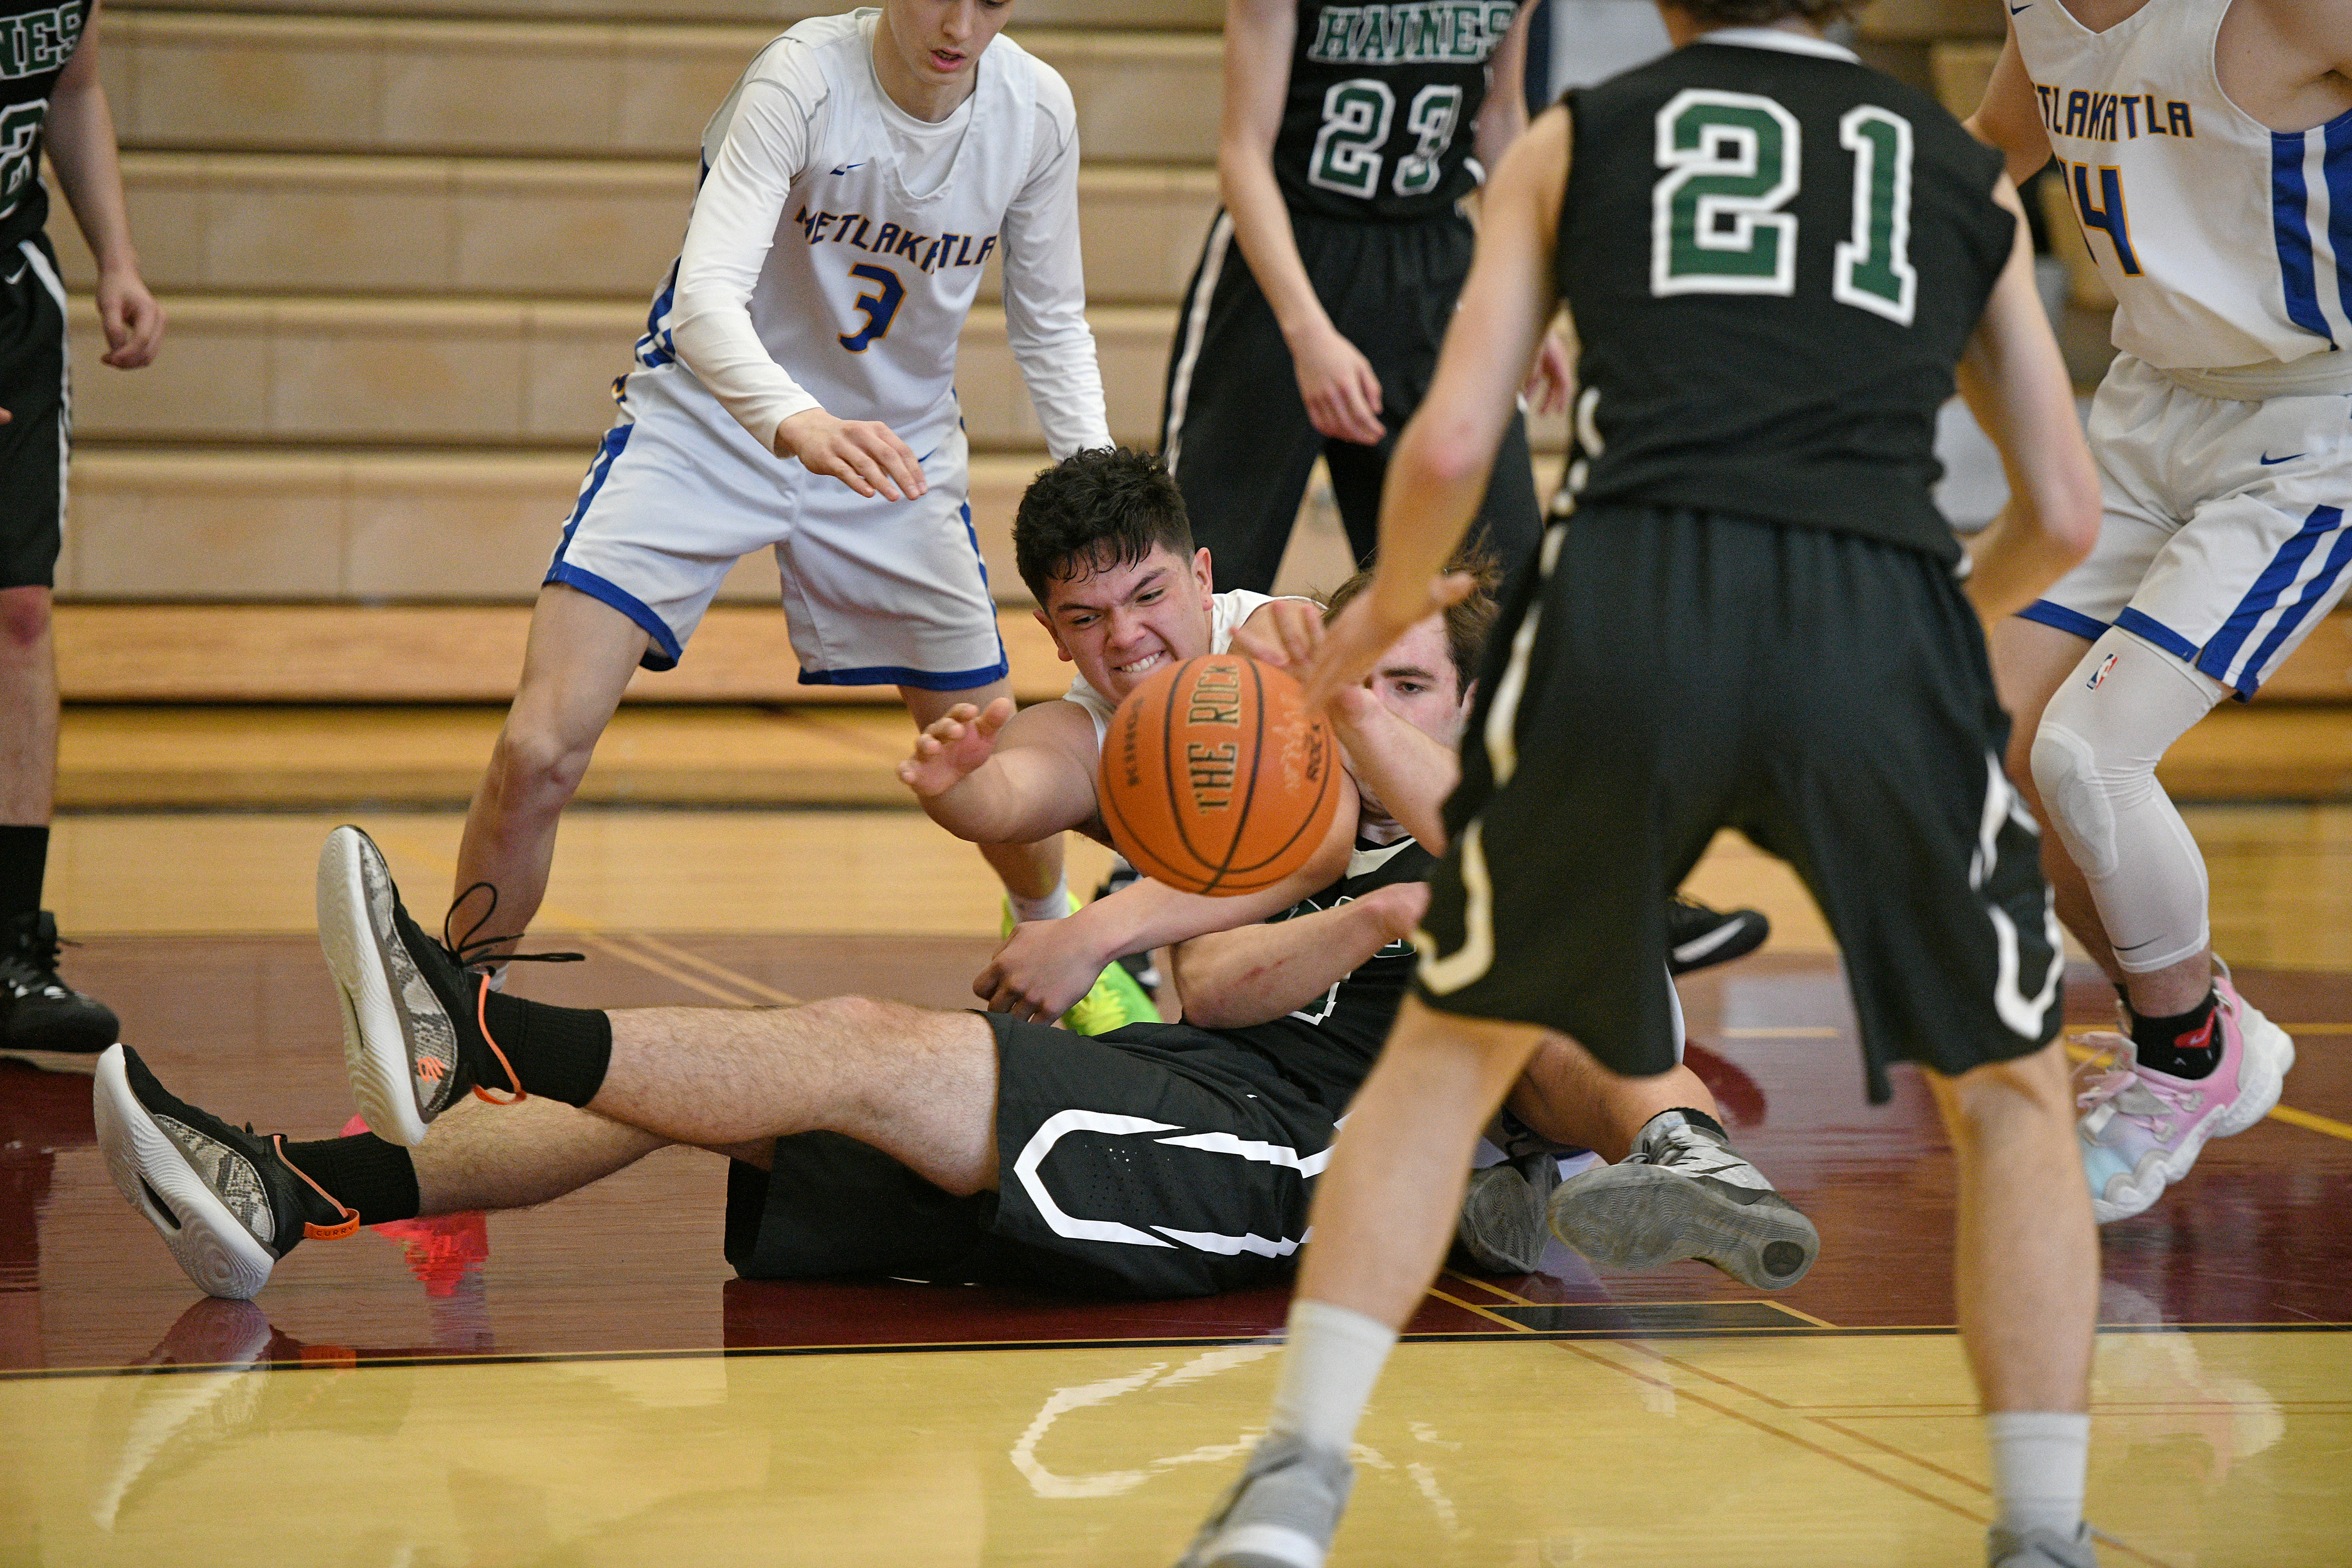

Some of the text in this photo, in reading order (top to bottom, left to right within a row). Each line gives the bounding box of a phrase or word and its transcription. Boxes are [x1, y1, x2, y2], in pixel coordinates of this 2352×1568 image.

[1306, 2, 1519, 65] HAINES
[1307, 78, 1463, 200] 23
[2032, 80, 2195, 143] TLAKATLA
[793, 203, 998, 275] METLAKATLA
[1650, 87, 1918, 327] 21
[837, 261, 907, 354] 3
[1187, 662, 1241, 814] THE ROCK
